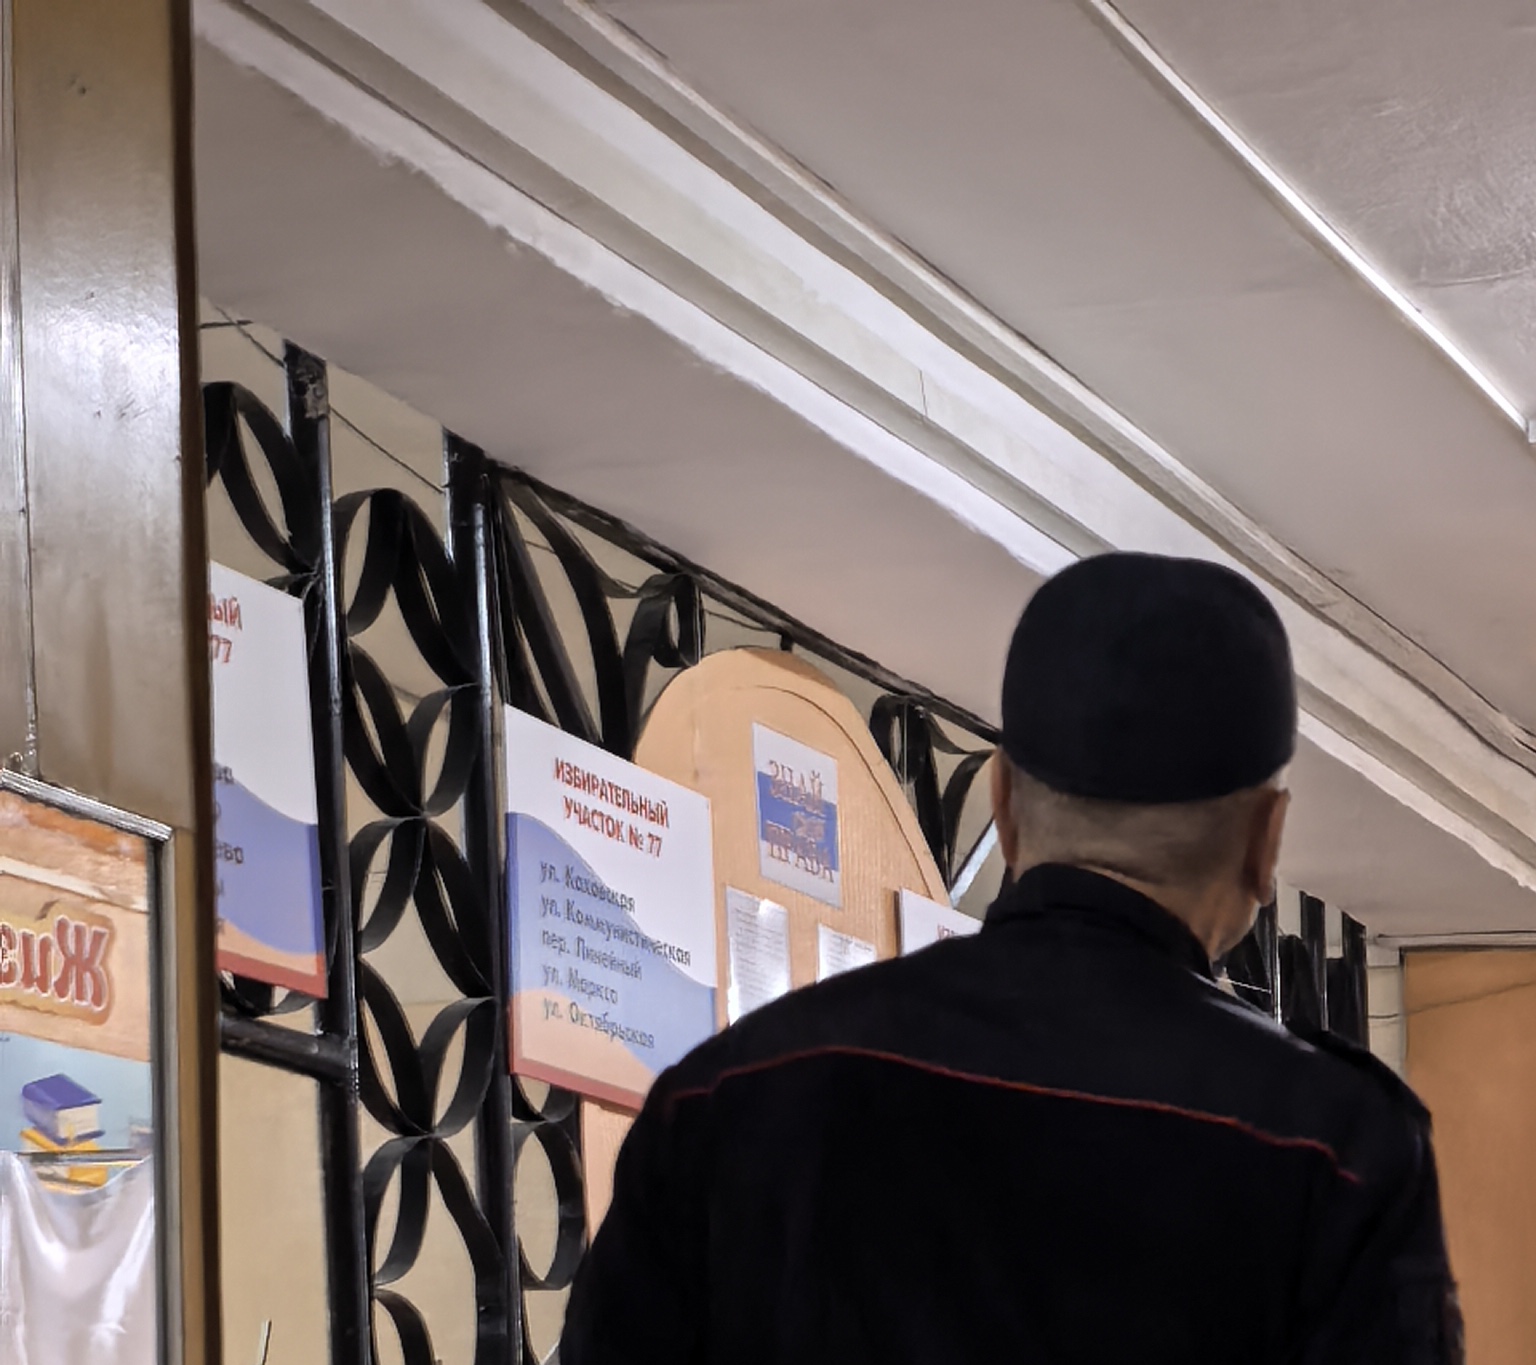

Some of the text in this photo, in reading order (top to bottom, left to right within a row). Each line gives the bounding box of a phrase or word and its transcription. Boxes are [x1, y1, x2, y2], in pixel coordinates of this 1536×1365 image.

[554, 757, 670, 828] ИЗБИРАТЕЛЬНЫЙ
[563, 795, 663, 858] УЧАСТОК № 77
[540, 860, 560, 884] ул.
[541, 894, 561, 918] ул.
